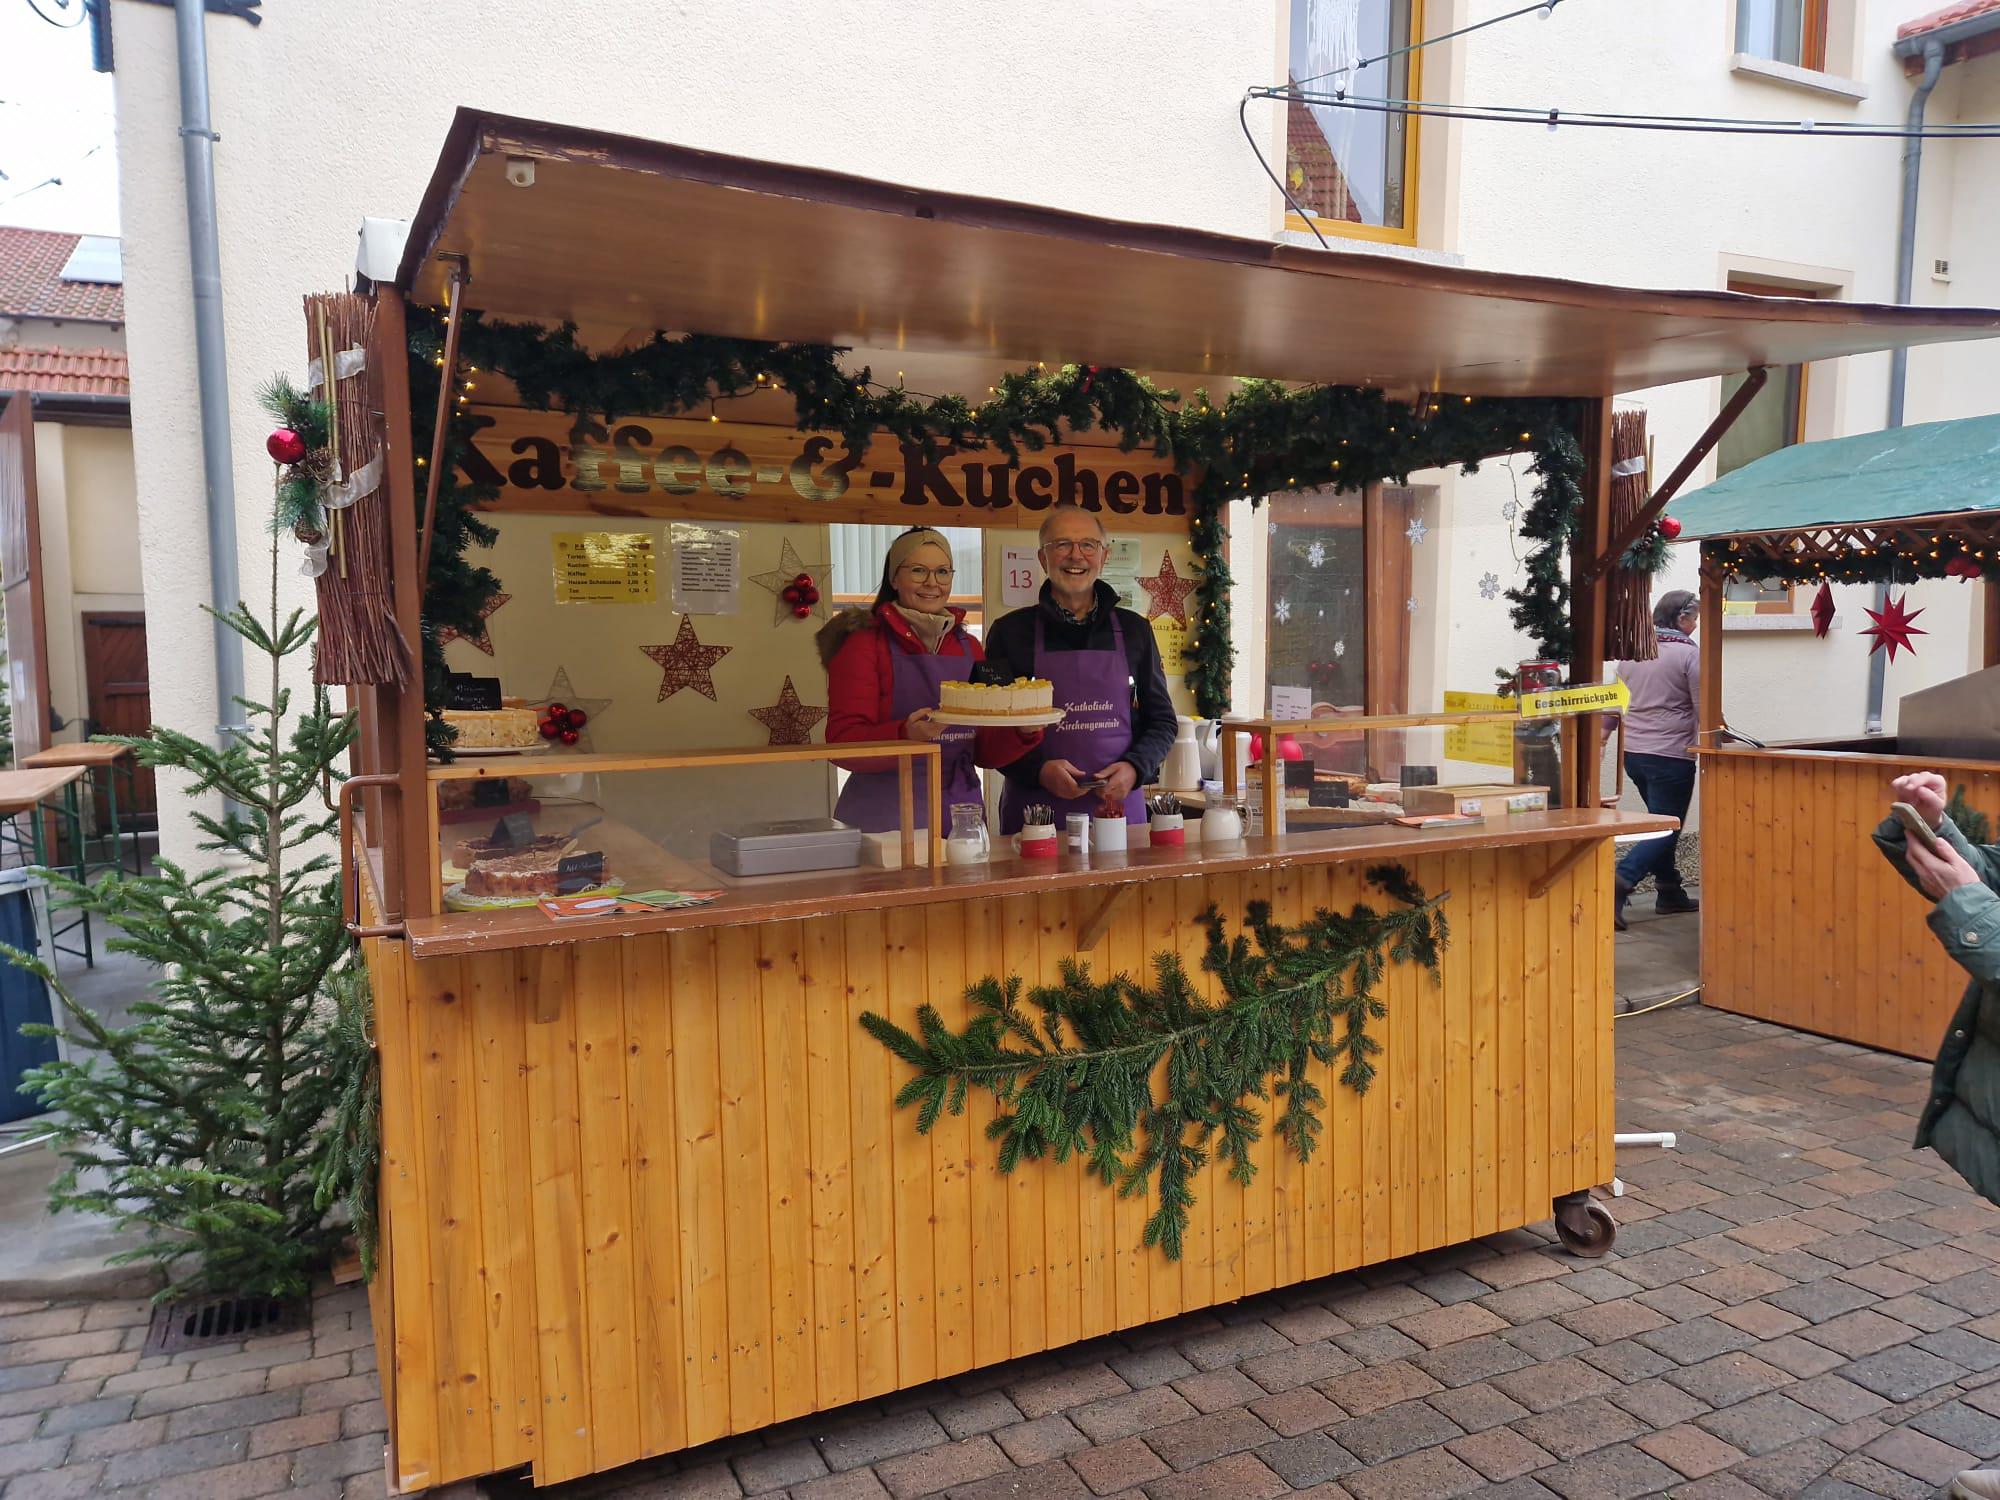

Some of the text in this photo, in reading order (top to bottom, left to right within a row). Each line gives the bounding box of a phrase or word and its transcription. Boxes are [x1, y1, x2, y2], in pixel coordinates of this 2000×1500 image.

[1010, 569, 1033, 589] 13
[1064, 700, 1114, 713] Katholische
[1056, 717, 1121, 733] Kirchengemeinde
